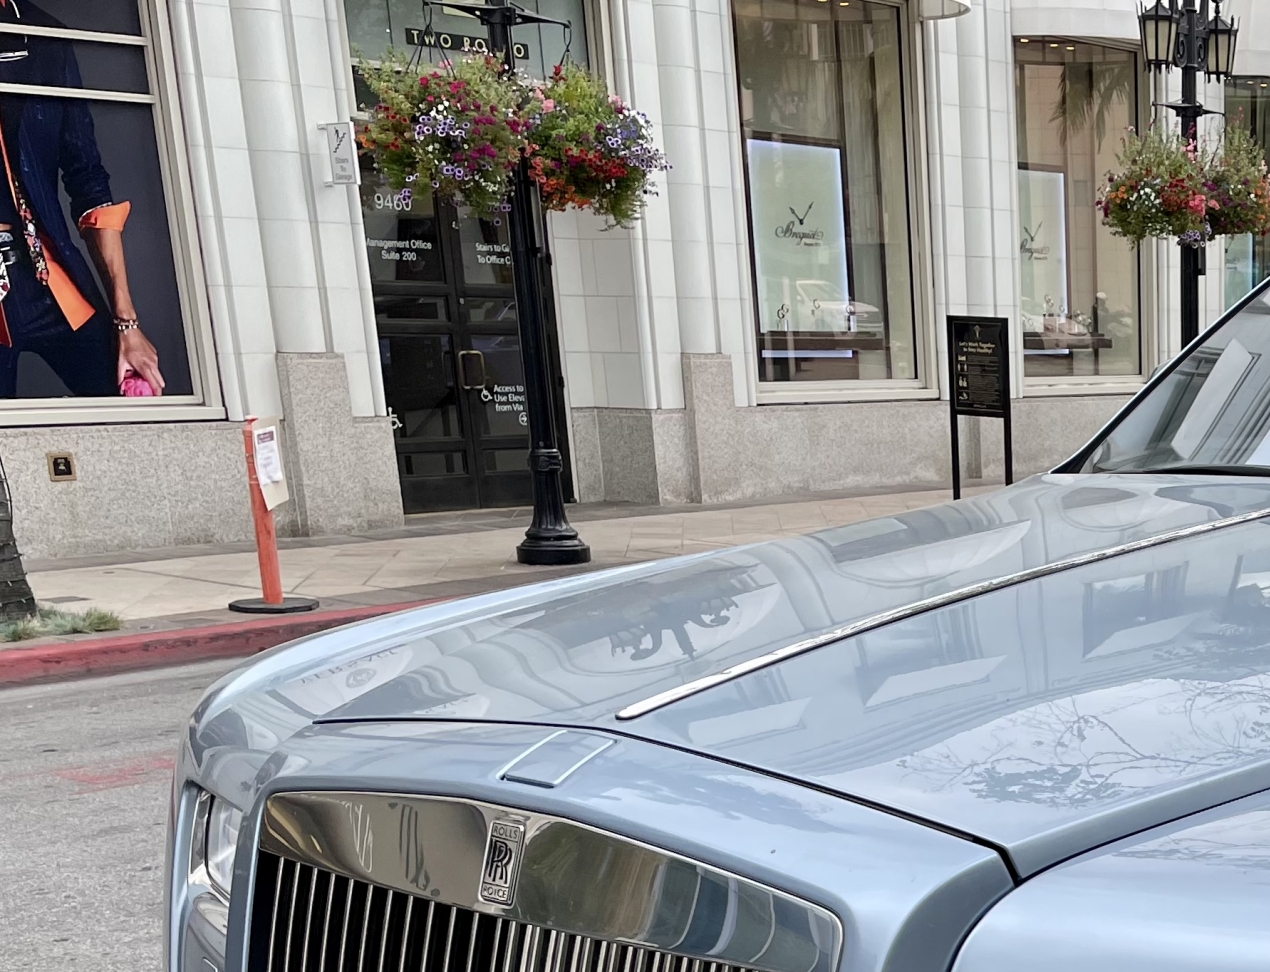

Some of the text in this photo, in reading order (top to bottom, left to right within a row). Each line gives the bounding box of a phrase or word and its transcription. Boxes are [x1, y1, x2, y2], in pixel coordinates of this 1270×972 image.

[411, 30, 525, 58] TWO ROO
[411, 239, 433, 250] Office
[475, 242, 493, 252] Stairs
[494, 244, 501, 252] to
[381, 250, 417, 261] Suite 200
[476, 254, 486, 264] To
[485, 254, 505, 264] Office
[494, 384, 525, 392] Access to
[494, 394, 508, 402] Use
[495, 403, 513, 412] from
[493, 825, 519, 839] ROLLS
[482, 886, 508, 899] ROYCE
